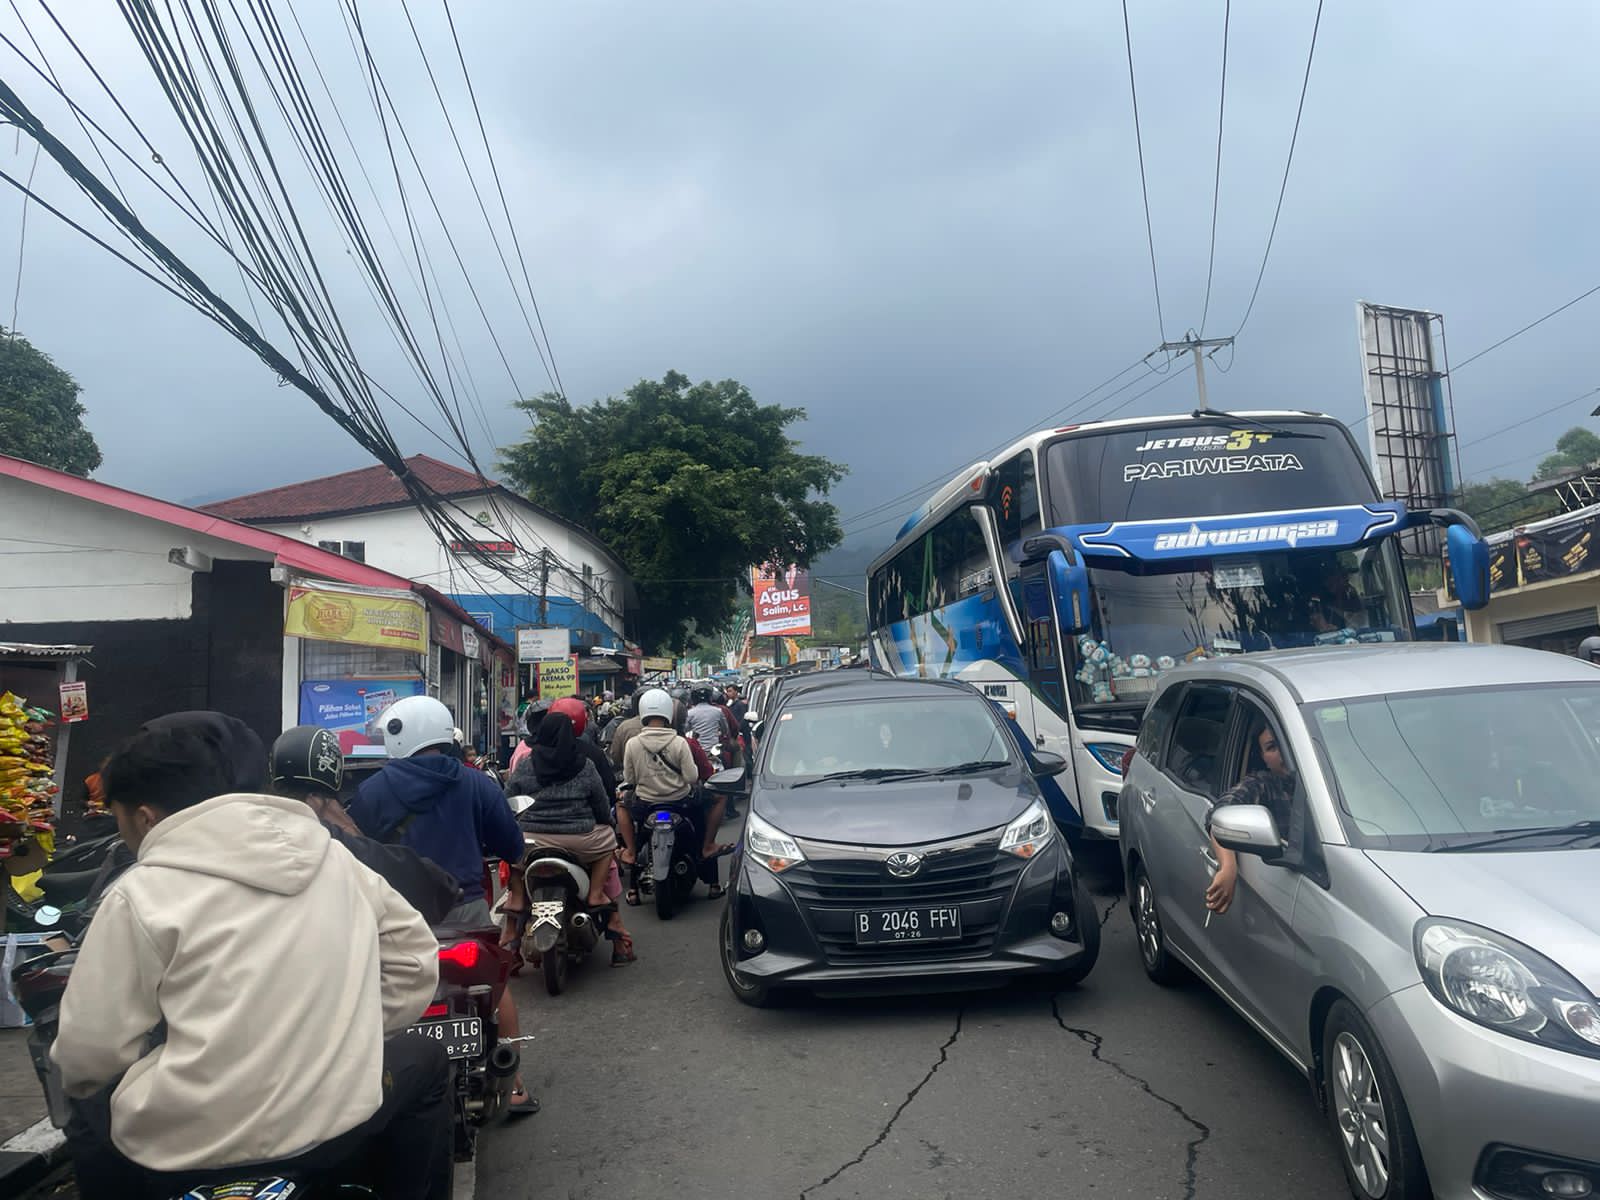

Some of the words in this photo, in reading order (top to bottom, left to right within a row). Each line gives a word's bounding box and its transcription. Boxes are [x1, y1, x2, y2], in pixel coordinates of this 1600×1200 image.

[1136, 435, 1230, 451] JETBUS
[1124, 453, 1304, 482] PARIWISATA
[759, 589, 800, 605] Agus
[762, 604, 792, 616] Salim,
[792, 602, 808, 612] Lc.
[541, 675, 565, 683] AREMA
[545, 667, 570, 675] BAKSO
[860, 914, 869, 933] B
[881, 911, 919, 931] 2046
[930, 908, 957, 928] FFV
[452, 1021, 478, 1038] TLG
